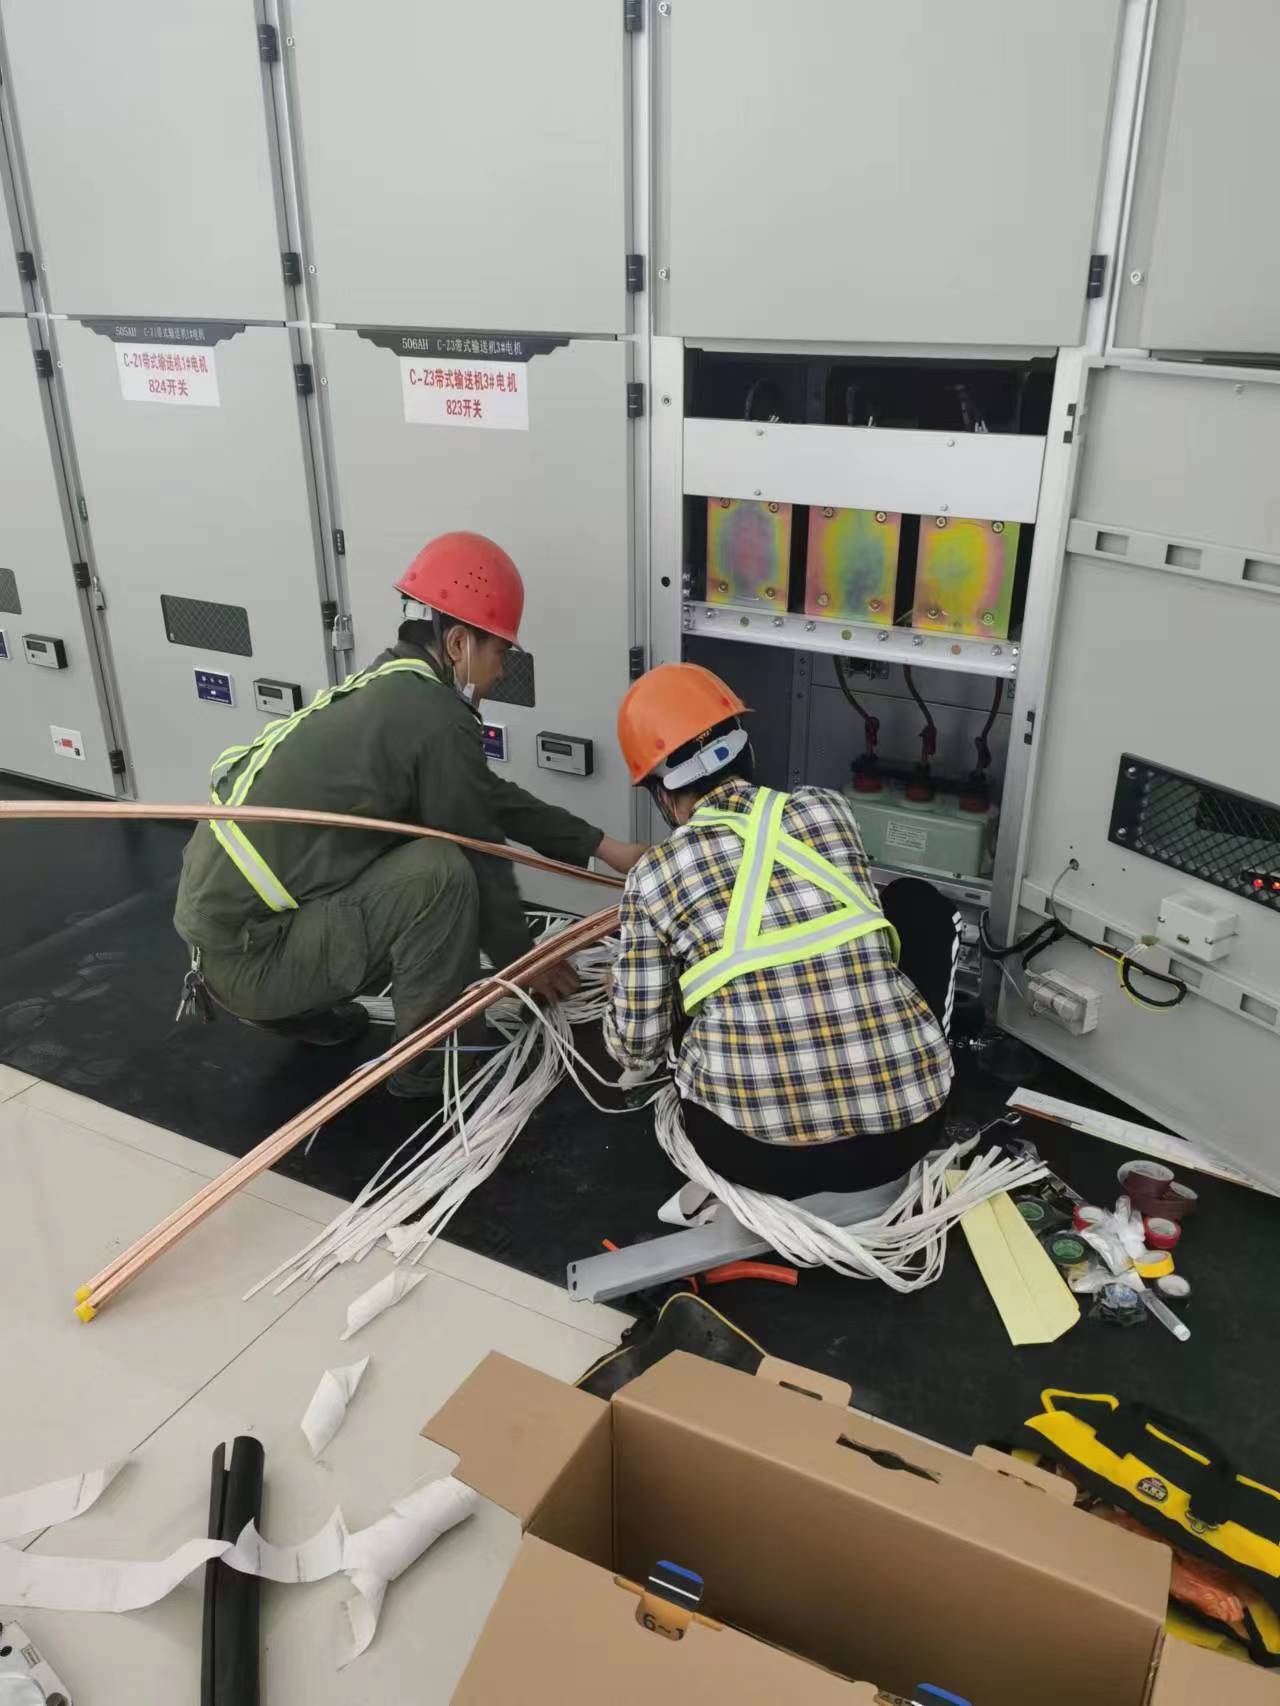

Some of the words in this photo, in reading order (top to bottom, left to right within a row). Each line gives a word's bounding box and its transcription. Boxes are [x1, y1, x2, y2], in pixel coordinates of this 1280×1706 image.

[401, 337, 429, 351] 506AH
[148, 379, 189, 396] 824开关
[446, 399, 483, 418] 823开关
